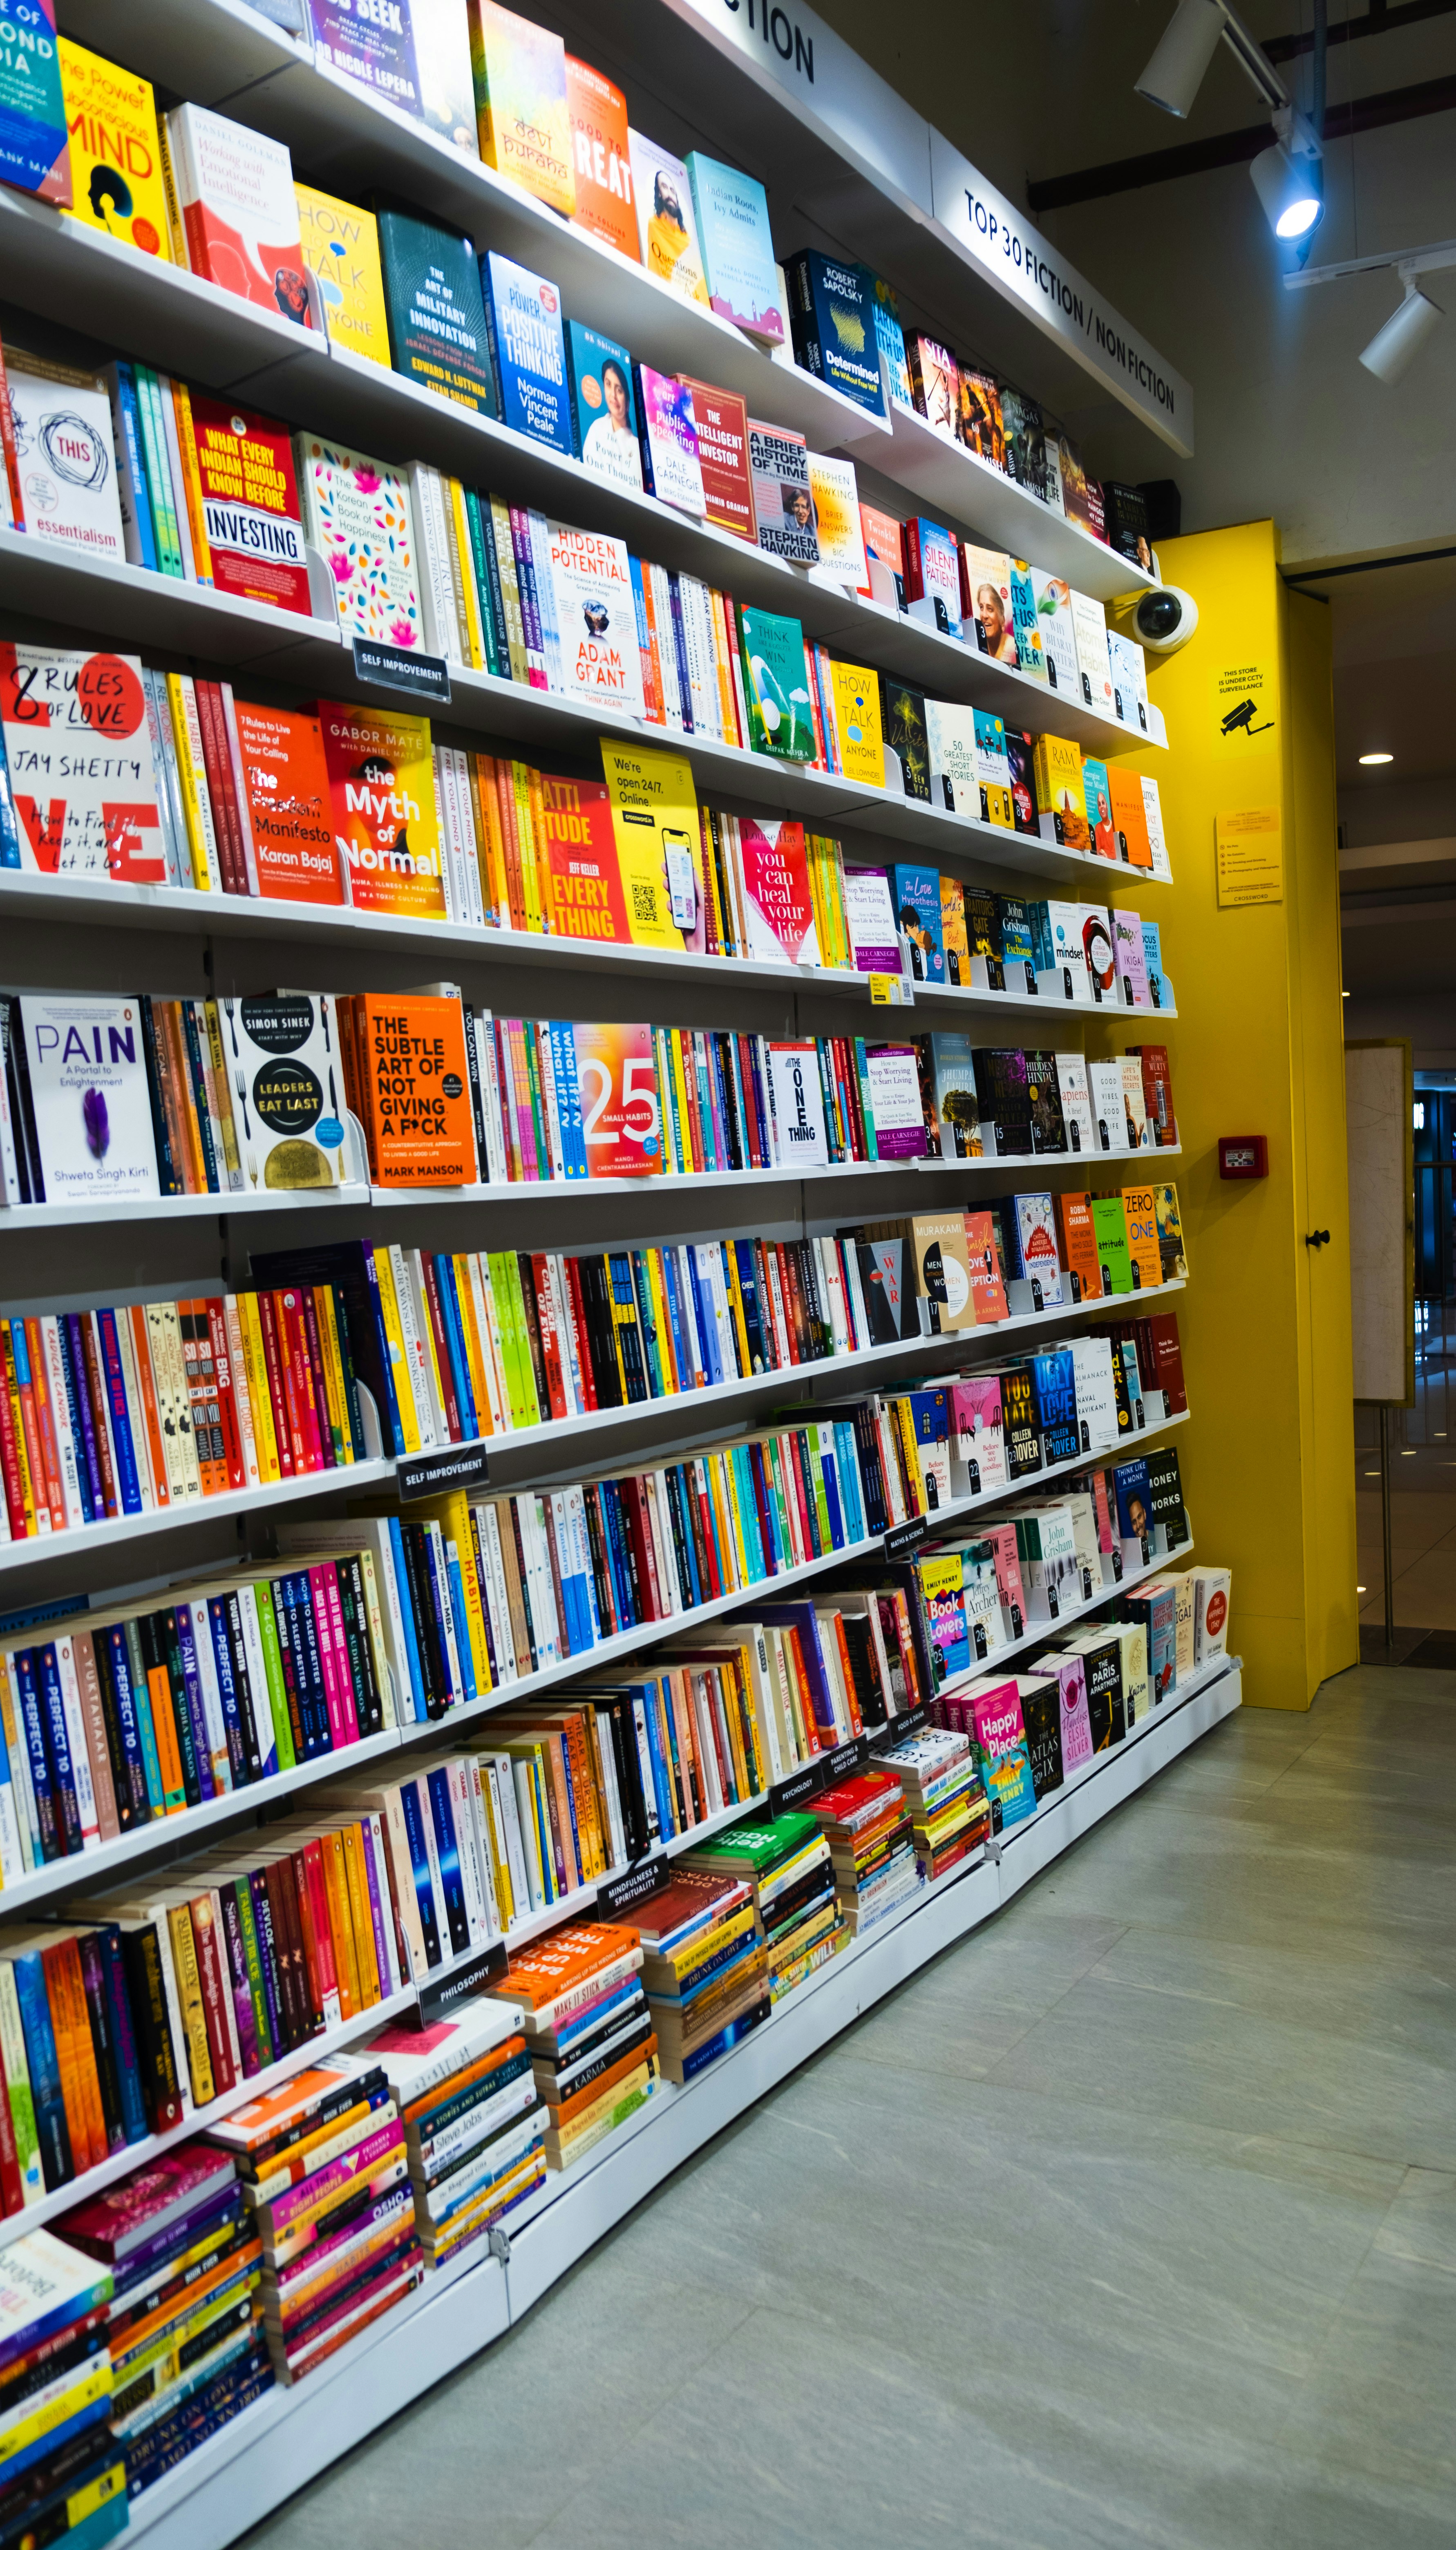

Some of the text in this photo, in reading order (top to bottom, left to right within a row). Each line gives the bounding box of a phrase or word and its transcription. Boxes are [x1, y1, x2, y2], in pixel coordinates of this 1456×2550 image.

[965, 188, 998, 242] TOP
[1002, 226, 1022, 266] 30
[1026, 246, 1083, 327] FICTION
[1096, 316, 1125, 368] NON
[1128, 344, 1174, 414] FICTION
[502, 305, 559, 357] POSITIVE
[506, 335, 563, 386] THINKING
[57, 436, 90, 462] THIS
[206, 428, 274, 465] WHAT EVERY
[750, 432, 805, 456] A BRIEF
[750, 445, 807, 468] HISTORY
[201, 448, 286, 492] INDIAN SHOULD
[751, 457, 808, 481] OF TIME
[208, 471, 286, 512] KNOW BEFORE
[38, 519, 116, 547] essentialism
[208, 507, 297, 559] INVESTING
[558, 528, 616, 560] HIDDEN
[759, 528, 817, 549] STEPHEN
[760, 540, 820, 562] HAWKING
[925, 545, 955, 573] SILENT
[552, 548, 628, 582] POTENTIAL
[926, 568, 957, 592] PATIENT
[578, 642, 622, 668] ADAM
[362, 653, 442, 681] SELF IMPROVEMENT
[576, 662, 626, 689] GRANT
[1239, 667, 1257, 675] STORE
[839, 674, 871, 694] HOW
[1219, 682, 1263, 694] SURVEILLANCE
[1226, 677, 1246, 685] UNDER
[1248, 674, 1263, 682] CCTV
[10, 664, 124, 720] 8 RULES
[47, 702, 126, 725] OF LOVE
[841, 705, 874, 729] TALK
[846, 745, 876, 760] ANYONE
[944, 749, 973, 762] GREATEST
[953, 740, 963, 751] 50
[13, 751, 141, 779] JAY SHETTY
[365, 765, 395, 787] the
[614, 757, 641, 773] We're
[946, 768, 975, 782] STORIES
[950, 762, 970, 771] SHORT
[617, 777, 664, 794] open 24/7.
[345, 783, 420, 823] Myth
[620, 792, 651, 807] Online.
[1116, 801, 1142, 812] MANIFEST
[625, 814, 653, 824] crossword.in
[378, 825, 396, 843] of
[259, 846, 333, 874] Karan Bajaj
[340, 837, 438, 877] Normal
[756, 853, 785, 873] you
[765, 870, 794, 885] can
[905, 877, 933, 896] the Love
[554, 875, 608, 908] EVERY
[759, 881, 792, 904] heal
[901, 894, 938, 908] Hypothesis
[1234, 894, 1268, 902] CROSSWORD
[555, 906, 615, 937] THING
[767, 906, 804, 926] your
[1007, 903, 1024, 919] John
[777, 921, 804, 943] life
[1002, 917, 1030, 935] Grisham
[1006, 943, 1032, 959] Exchange
[1057, 942, 1084, 960] mindset
[246, 1017, 311, 1030] SIMON SINEK
[373, 1016, 409, 1035] THE
[36, 1025, 136, 1063] PAIN
[375, 1038, 445, 1055] SUBTLE
[377, 1058, 444, 1075] ART OF
[882, 1067, 911, 1076] Worrying
[260, 1081, 313, 1095] LEADERS
[378, 1078, 416, 1095] NOT
[879, 1077, 892, 1085] Start
[894, 1076, 913, 1085] Living
[259, 1097, 319, 1113] EAT LAST
[380, 1098, 445, 1116] GIVING
[576, 1058, 659, 1145] 25
[602, 1112, 651, 1123] SMALL HABITS
[877, 1130, 921, 1141] DALE CARNEGIE
[385, 1165, 463, 1177] MARK MANSON
[1069, 1206, 1086, 1215] ROBIN
[1125, 1194, 1153, 1213] ZERO
[916, 1223, 962, 1237] MURAKAMI
[1069, 1215, 1089, 1226] SHARMA
[1129, 1222, 1154, 1241] ONE
[1098, 1237, 1125, 1249] attitude
[406, 1458, 482, 1486] SELF IMPROVEMENT
[891, 1537, 905, 1548] MATHS
[909, 1528, 924, 1540] SCIENCE
[464, 1559, 480, 1615] HABIT
[929, 1597, 960, 1620] Book
[929, 1617, 965, 1641] Lovers
[181, 1637, 198, 1674] PAIN
[1092, 1669, 1116, 1686] PARIS
[85, 1658, 107, 1764] YUKTAHAAR
[898, 1720, 908, 1731] FOOD
[913, 1709, 925, 1722] DRINK
[981, 1711, 1018, 1737] Happy
[831, 1750, 853, 1765] PARENTING
[989, 1736, 1019, 1759] Place
[834, 1755, 858, 1774] CHILD CARE
[782, 1778, 812, 1801] PSYCHOLOGY
[608, 1865, 659, 1898] MINDFULNESS &
[615, 1878, 656, 1906] SPIRITUALITY
[560, 1944, 627, 1990] BARKING UP THE WRONG TREE
[441, 1966, 489, 2003] PHILOSOPHY
[553, 1979, 601, 2020] MAKE IT STICK
[574, 2059, 606, 2093] KARMA
[436, 2112, 482, 2149] Steve Jobs
[373, 2190, 404, 2221] OSHO
